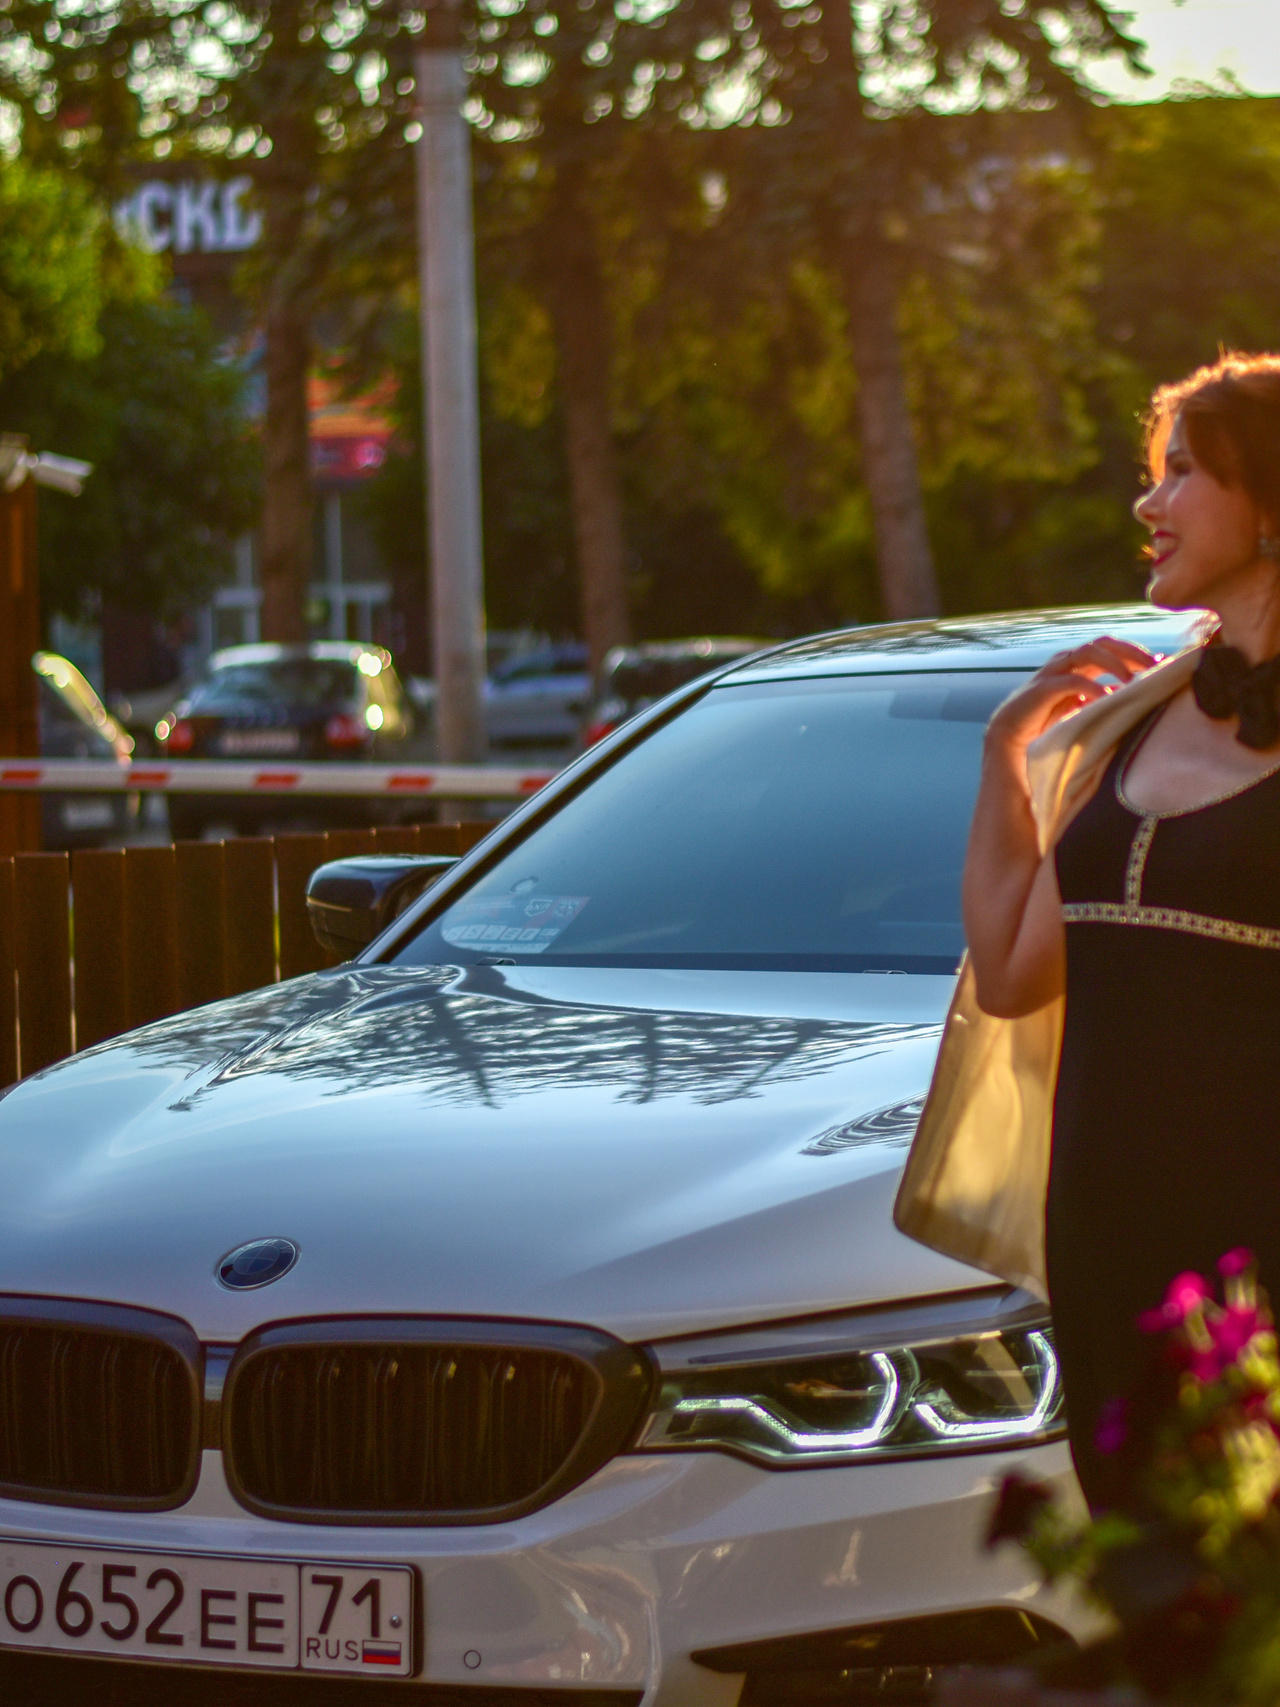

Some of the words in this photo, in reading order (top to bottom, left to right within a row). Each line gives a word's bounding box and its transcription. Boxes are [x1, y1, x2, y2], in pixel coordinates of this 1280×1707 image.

[4, 1561, 285, 1653] O652EE
[311, 1574, 381, 1639] 71
[305, 1637, 359, 1661] RUS
